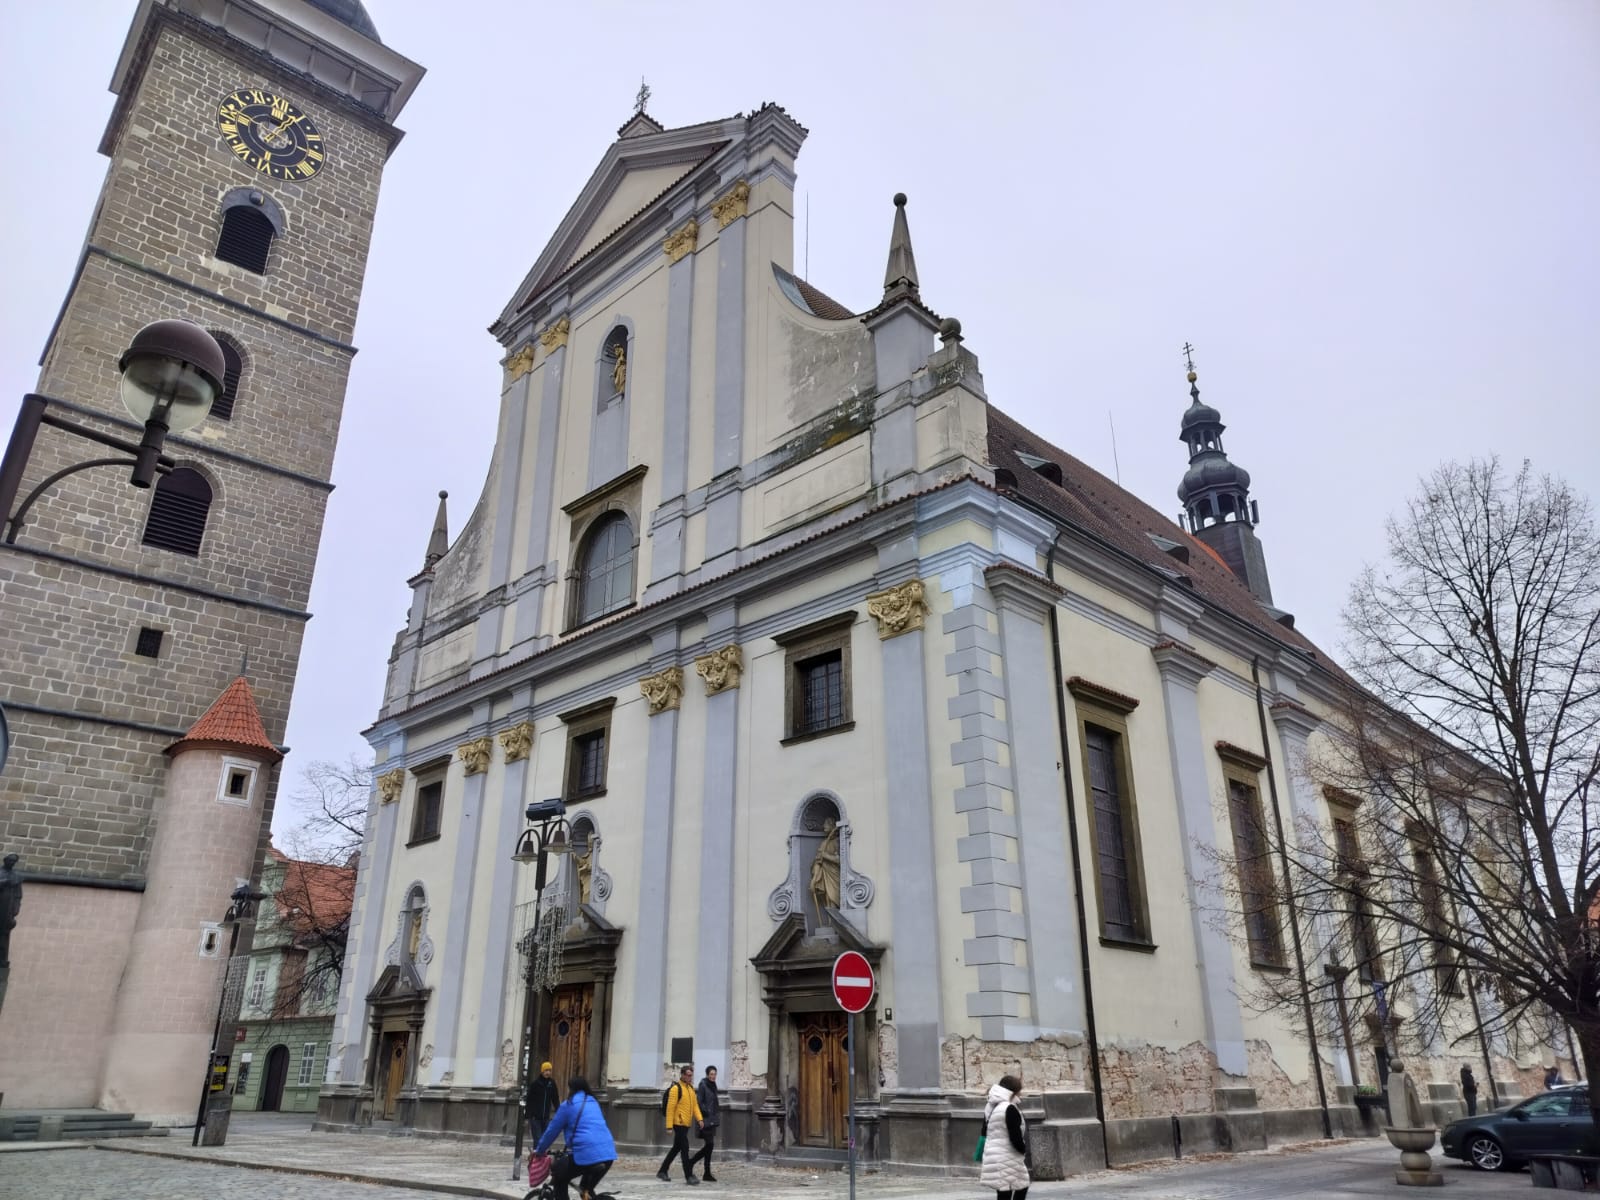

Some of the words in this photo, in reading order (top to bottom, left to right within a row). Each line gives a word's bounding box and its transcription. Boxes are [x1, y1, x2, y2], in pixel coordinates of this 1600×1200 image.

[248, 90, 266, 104] XI
[272, 95, 289, 113] XII
[307, 149, 323, 162] III
[284, 167, 295, 179] V
